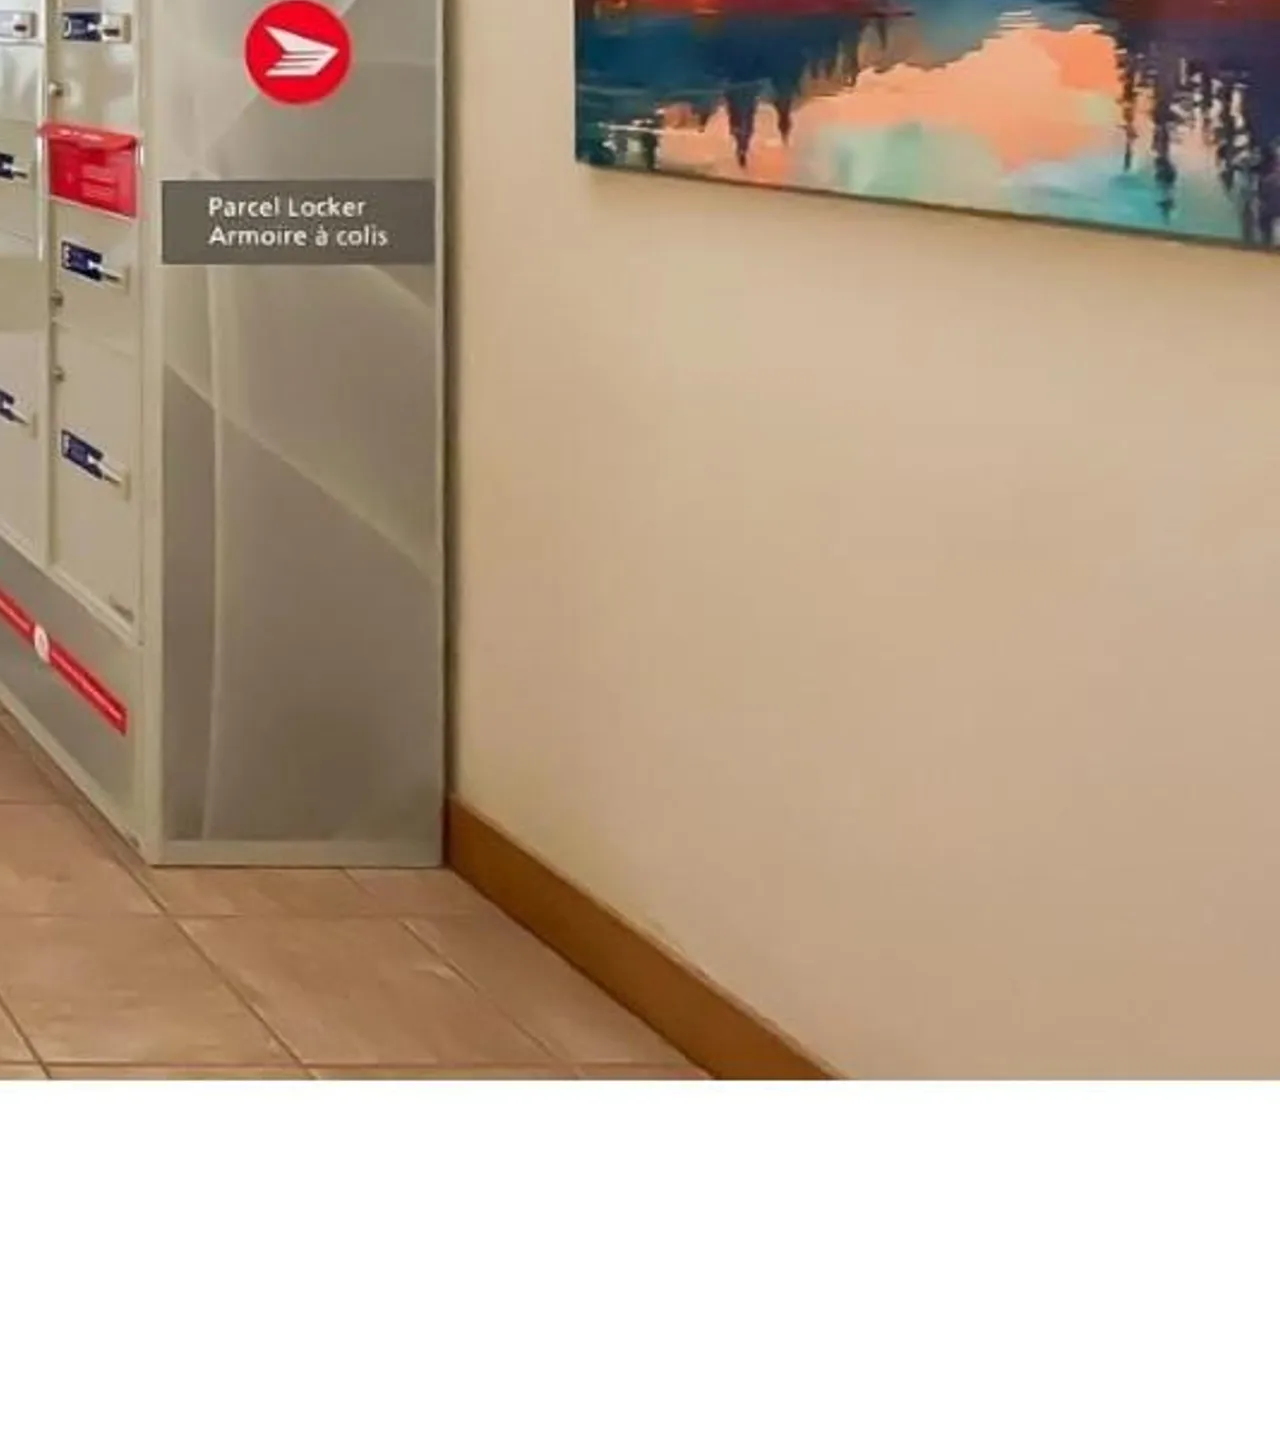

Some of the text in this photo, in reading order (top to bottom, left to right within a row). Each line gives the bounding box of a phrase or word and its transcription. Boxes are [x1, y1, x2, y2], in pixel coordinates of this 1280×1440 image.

[208, 195, 367, 217] Parcel Locker
[207, 224, 389, 247] Armoire à colis
